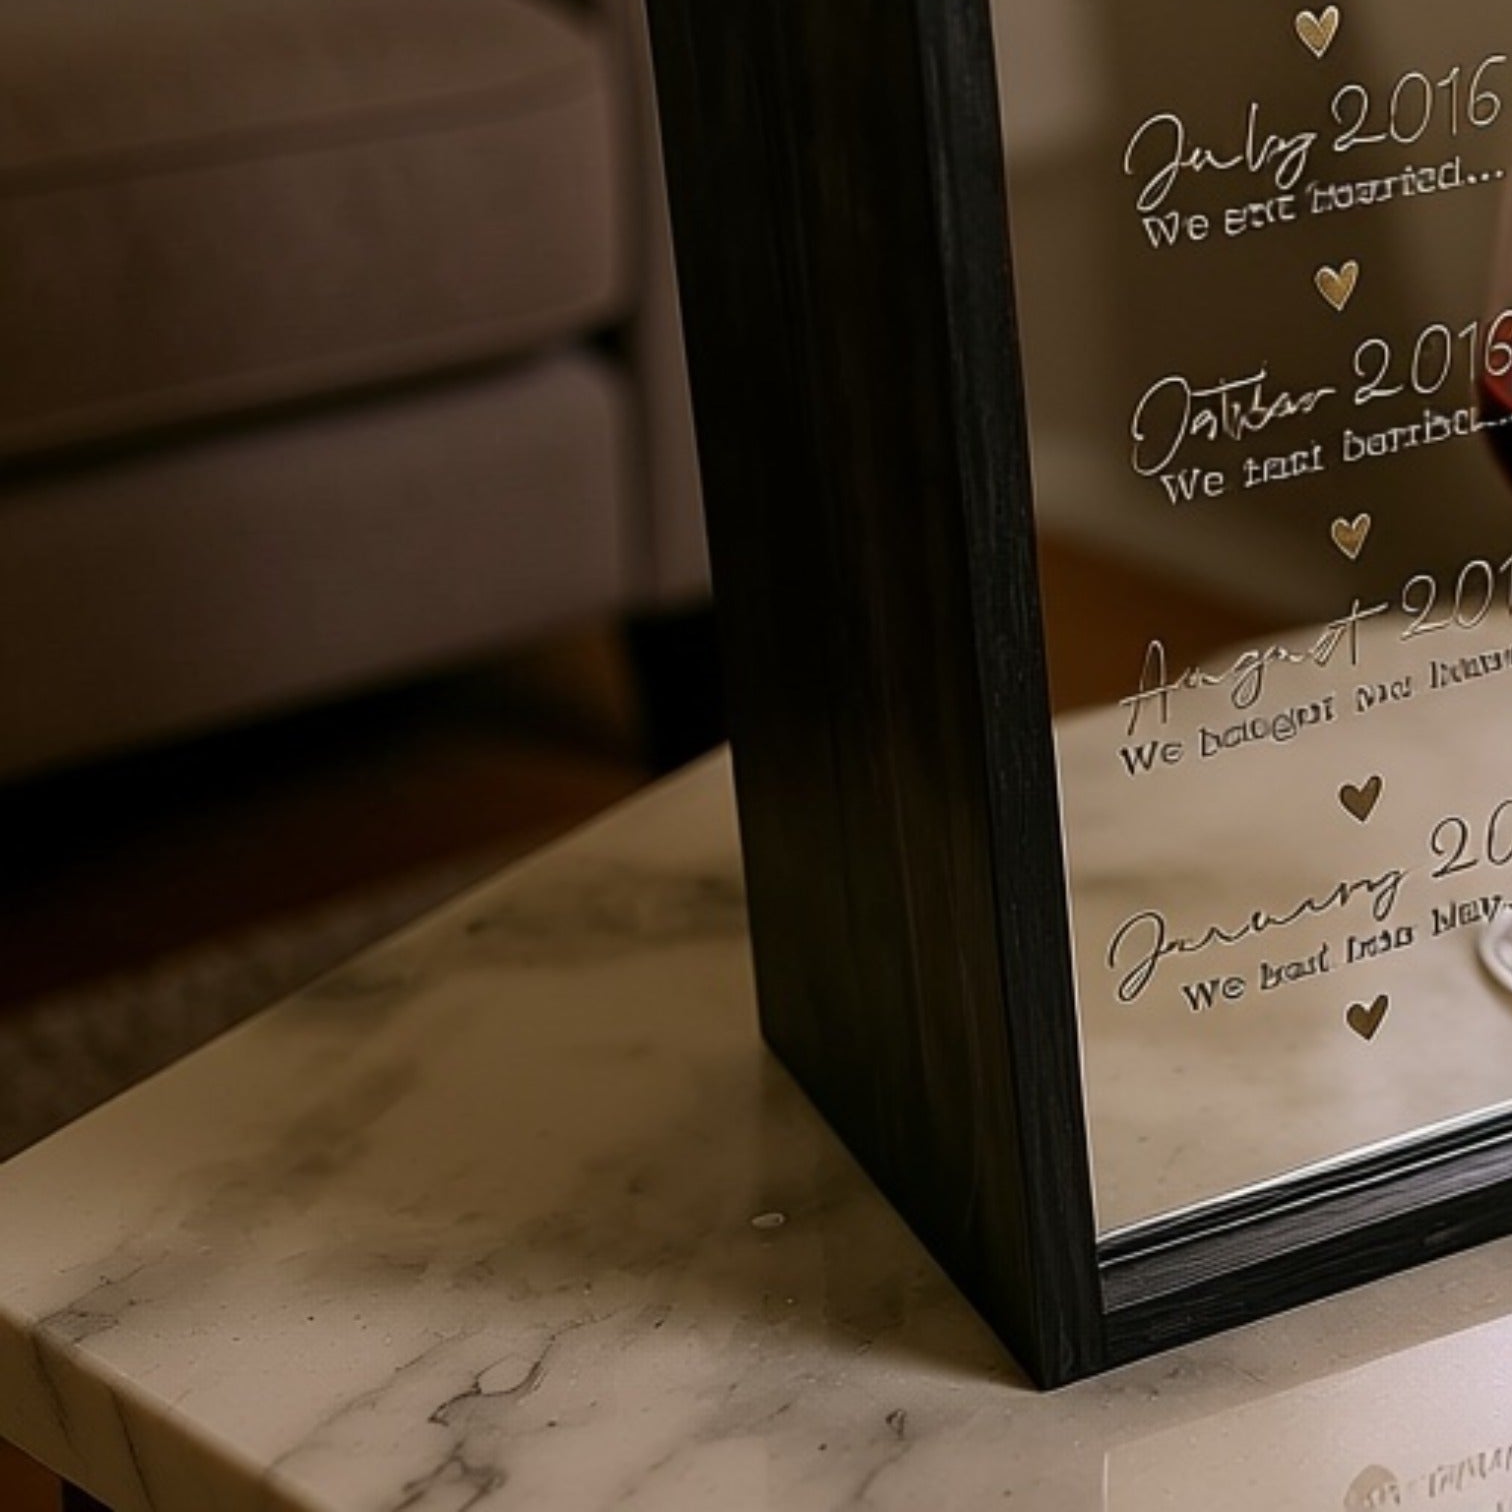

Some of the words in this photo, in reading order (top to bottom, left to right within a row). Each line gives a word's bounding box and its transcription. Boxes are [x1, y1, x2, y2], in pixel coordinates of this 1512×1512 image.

[1331, 54, 1508, 152] 2016
[1142, 212, 1211, 250] We
[1160, 472, 1225, 506] We
[1118, 740, 1184, 777] We
[1182, 974, 1246, 1012] We
